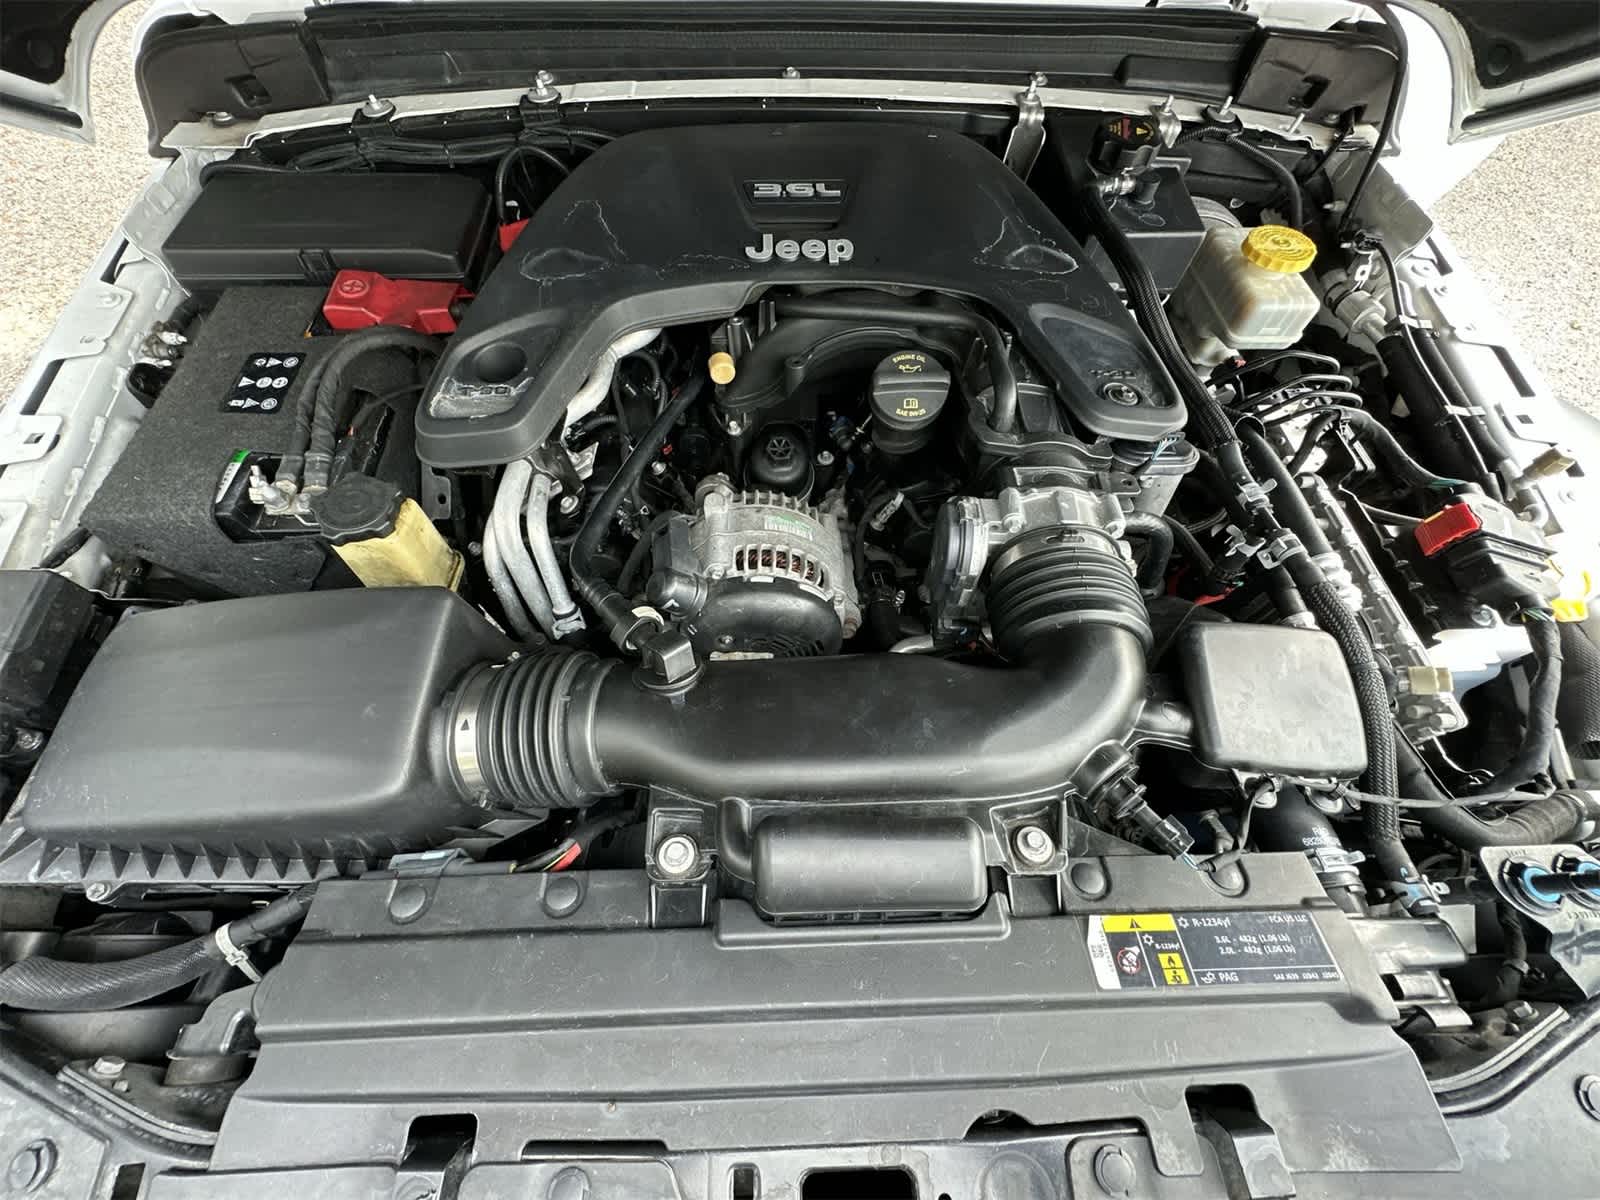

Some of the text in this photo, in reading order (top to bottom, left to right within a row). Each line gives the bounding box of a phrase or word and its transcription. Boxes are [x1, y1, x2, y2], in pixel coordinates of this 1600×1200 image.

[753, 183, 841, 197] 3.6L
[745, 234, 854, 265] Jeep
[892, 354, 926, 363] ENGINE OIL
[1192, 917, 1231, 928] R-1234yf
[1284, 915, 1295, 923] US
[1218, 972, 1239, 982] PAG
